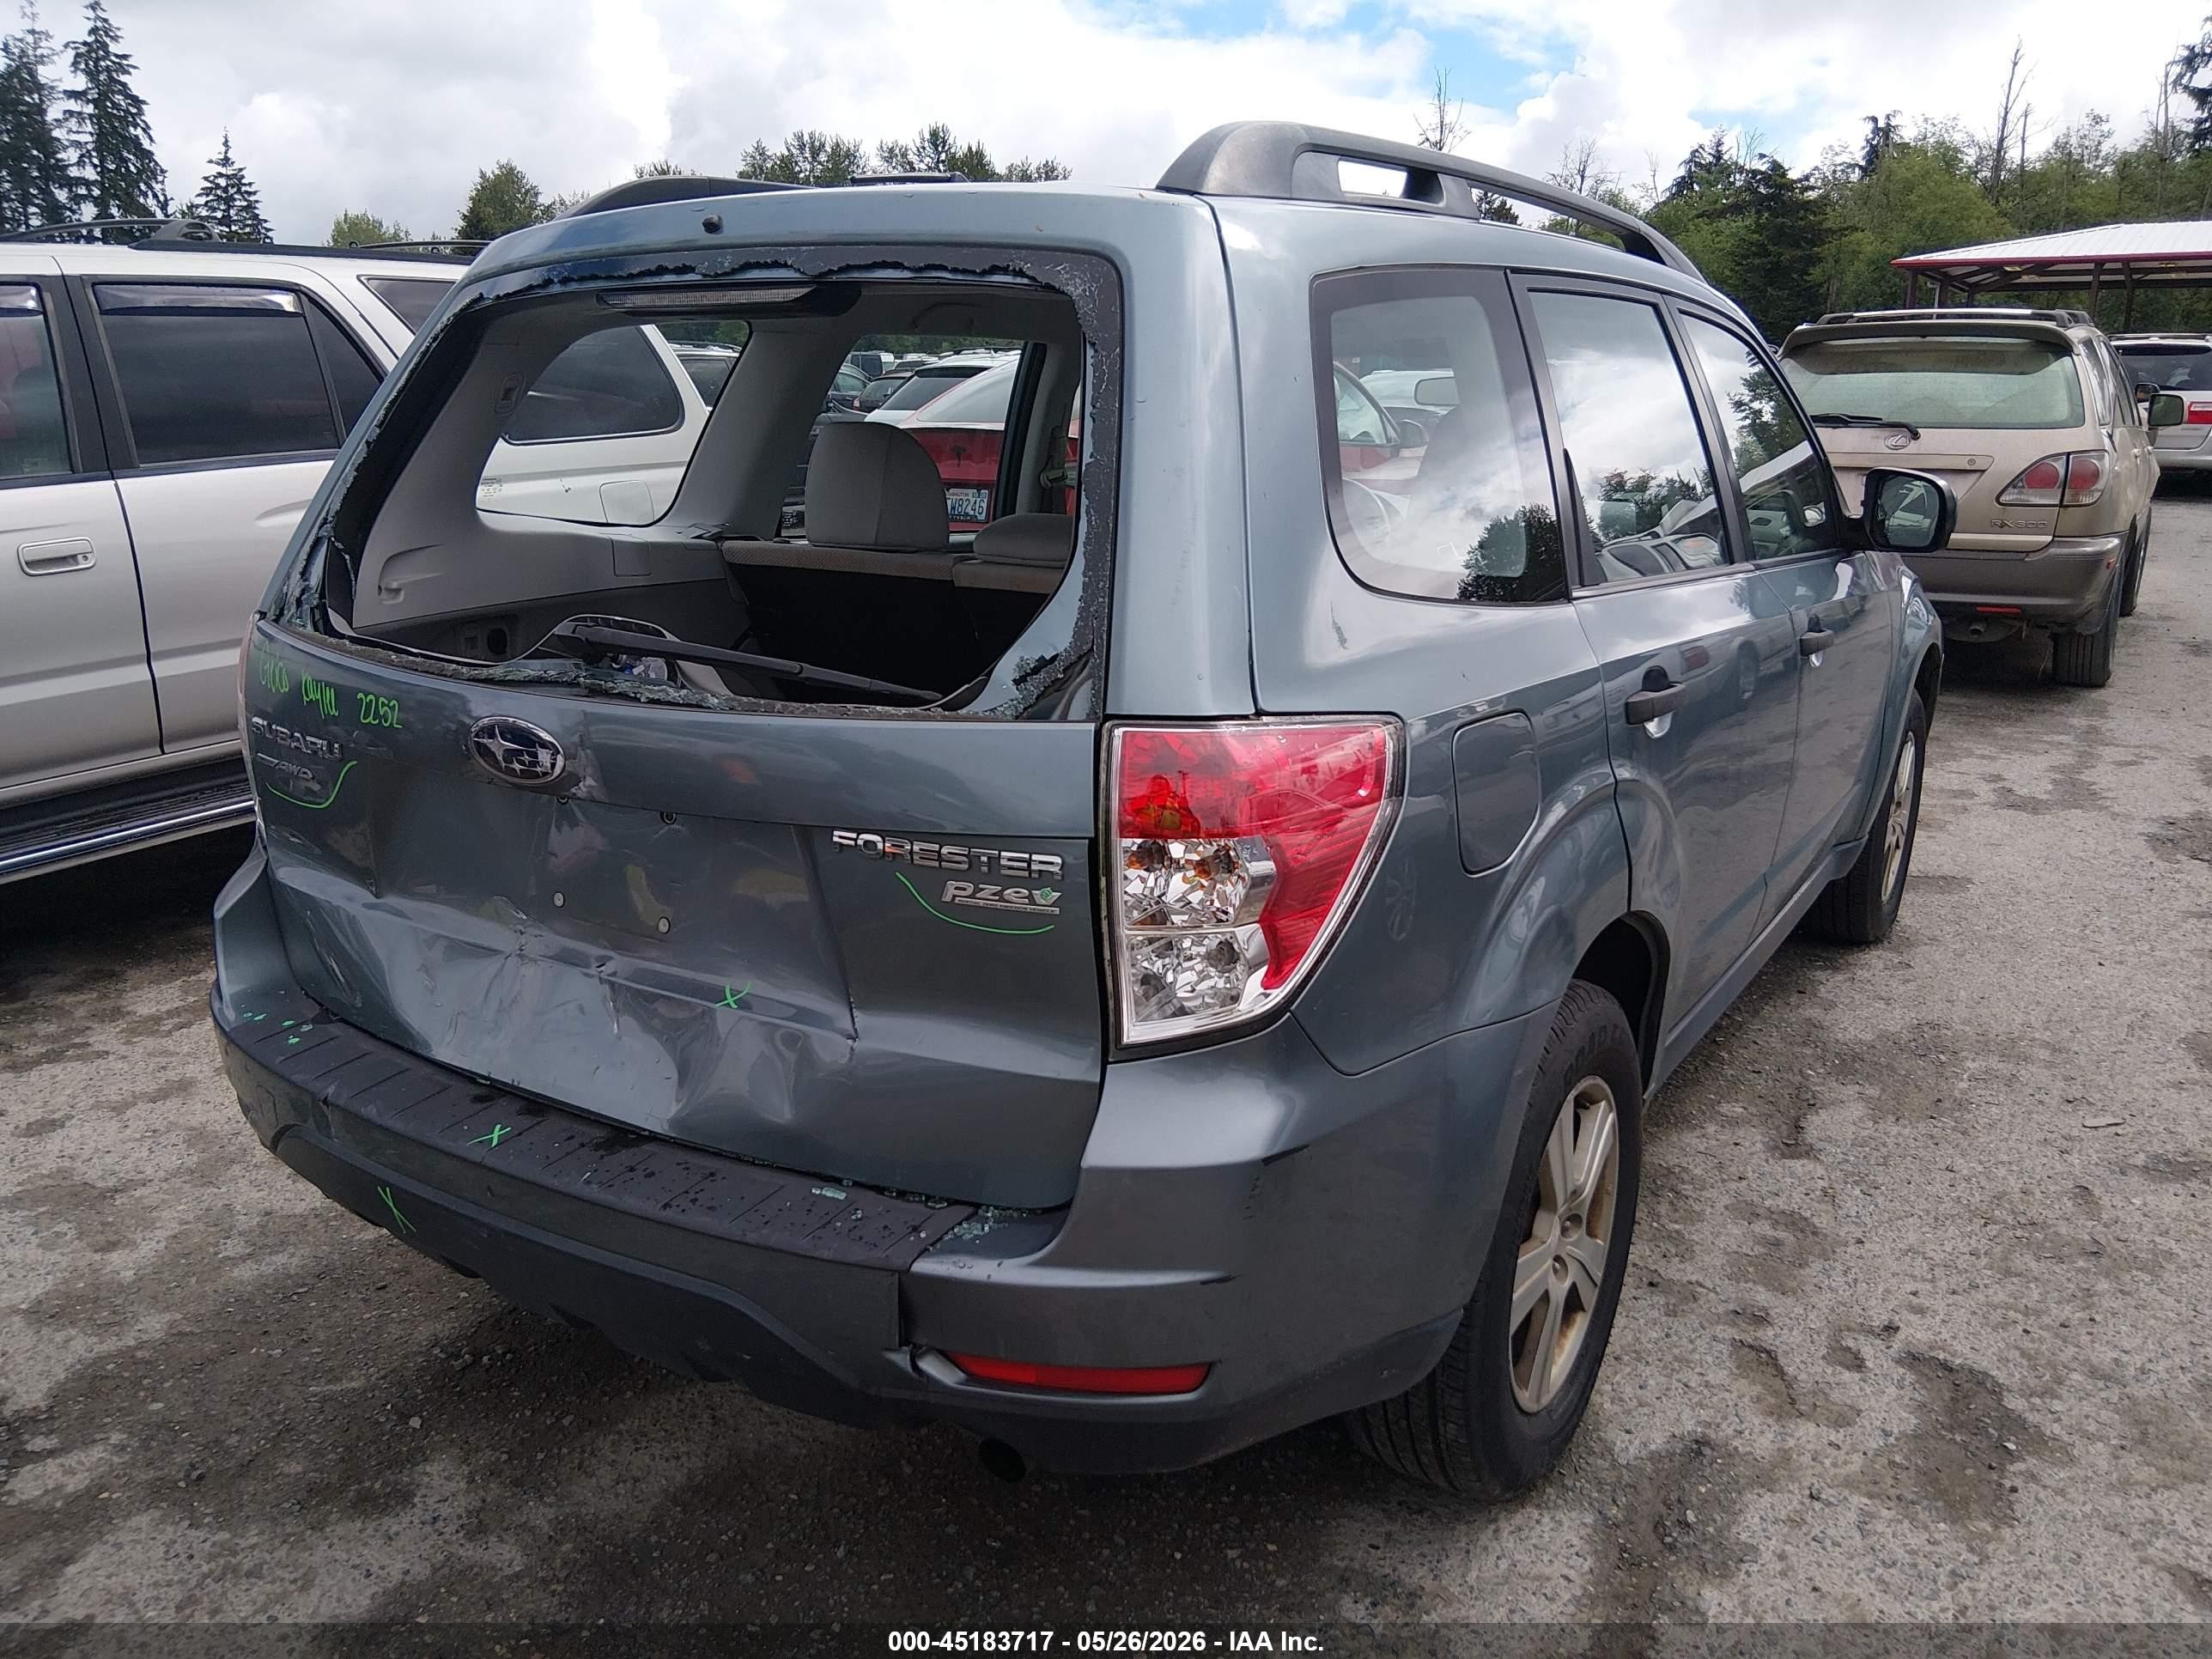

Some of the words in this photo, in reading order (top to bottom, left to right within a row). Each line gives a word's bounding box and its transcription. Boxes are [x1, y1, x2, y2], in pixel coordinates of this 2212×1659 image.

[947, 498, 986, 515] W8246
[1991, 520, 2013, 528] RX
[357, 692, 404, 728] 2252
[252, 716, 343, 762] SUBARU
[275, 761, 315, 781] AWD
[832, 830, 1064, 880] FORESTER
